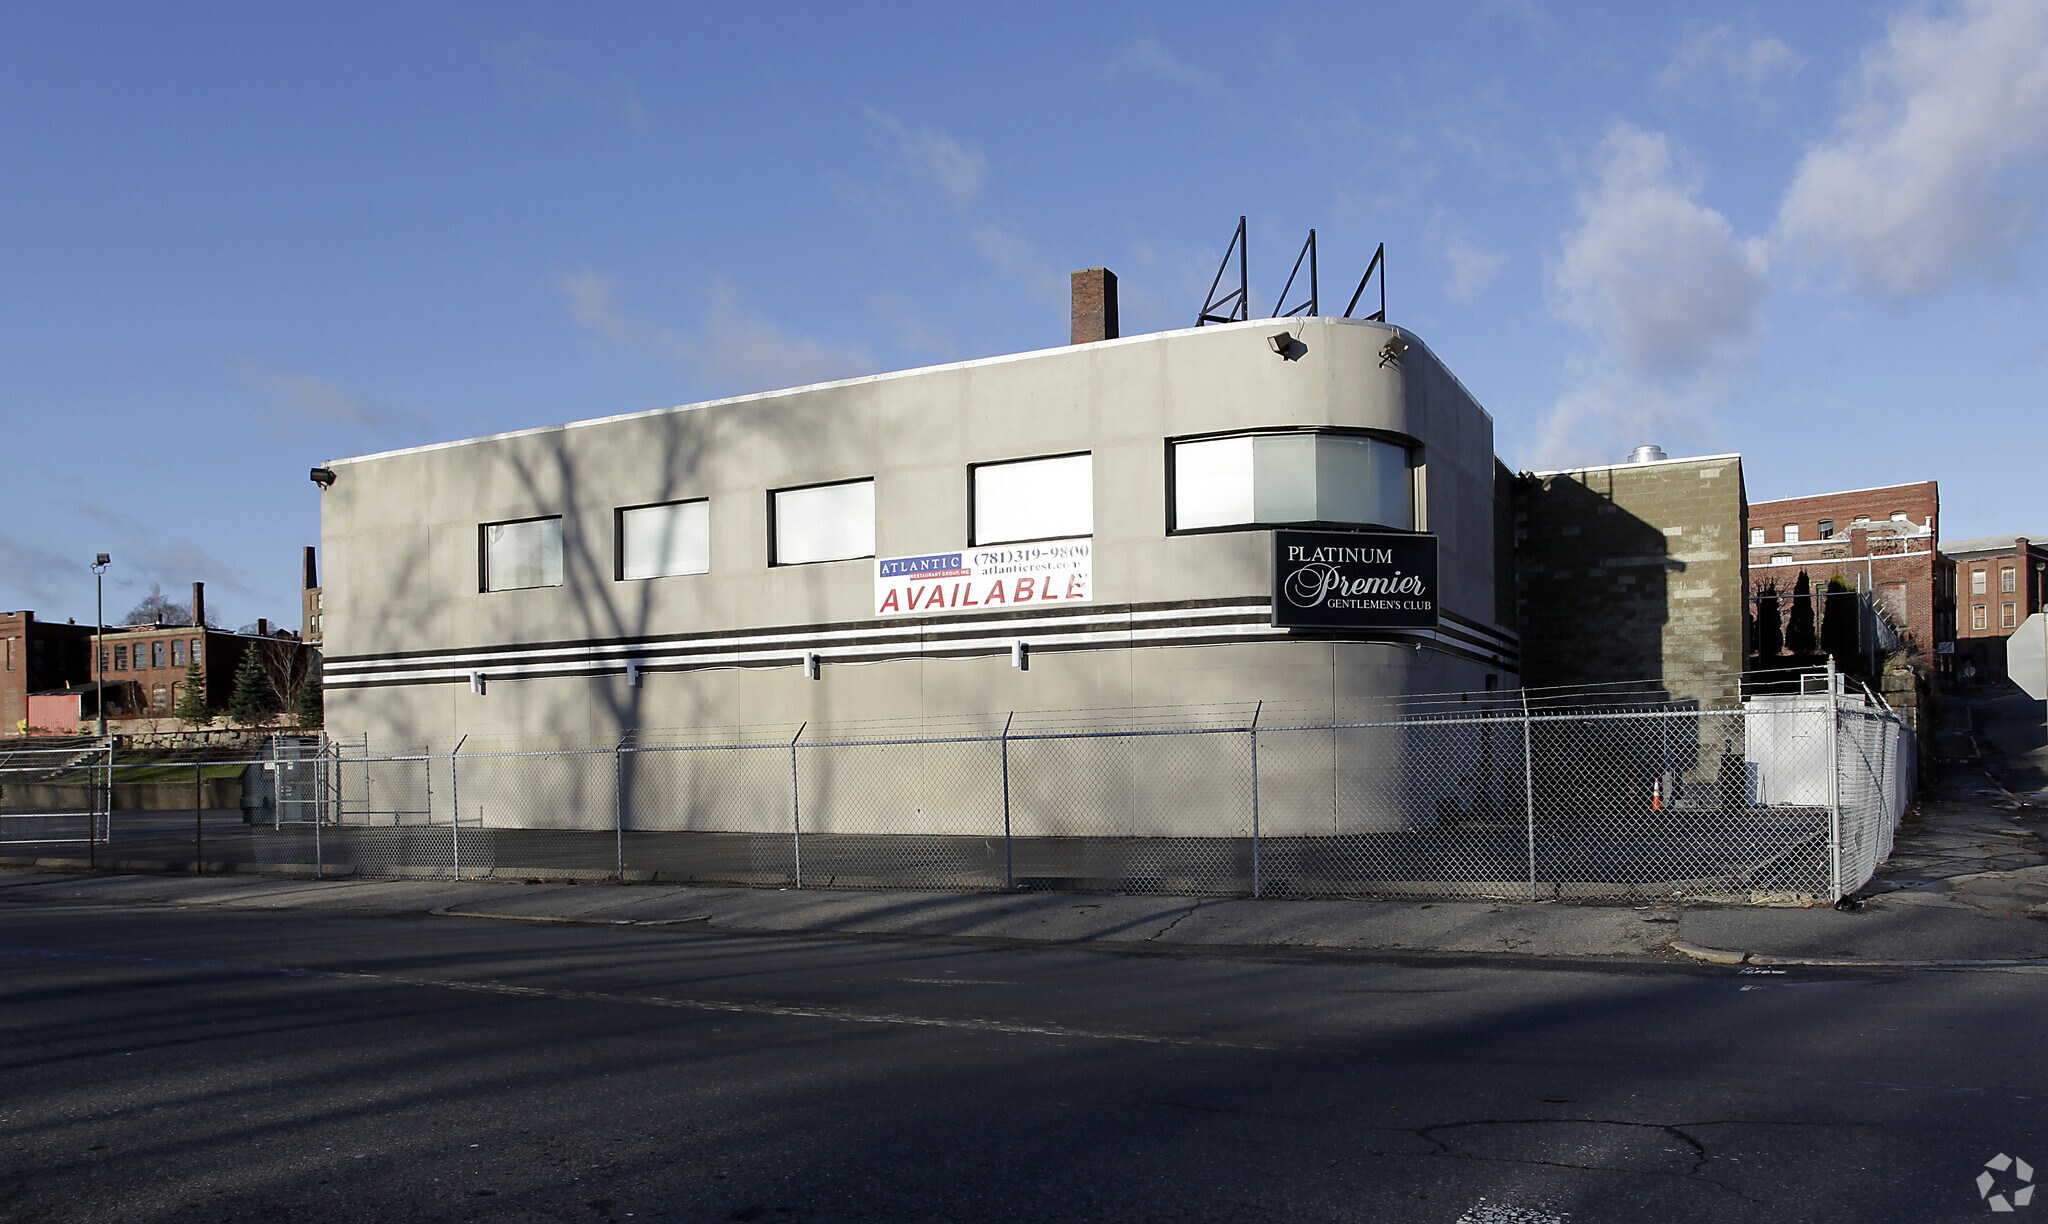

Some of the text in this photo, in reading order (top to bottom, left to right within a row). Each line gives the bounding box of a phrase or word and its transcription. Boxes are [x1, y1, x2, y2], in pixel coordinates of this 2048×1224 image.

[1288, 546, 1393, 564] PLATINUM
[882, 557, 960, 574] ATLANTIC
[880, 575, 1086, 613] AVAILABLE
[1284, 562, 1426, 608] Premier
[1327, 598, 1432, 611] GENTLEMEN'S CLUB
